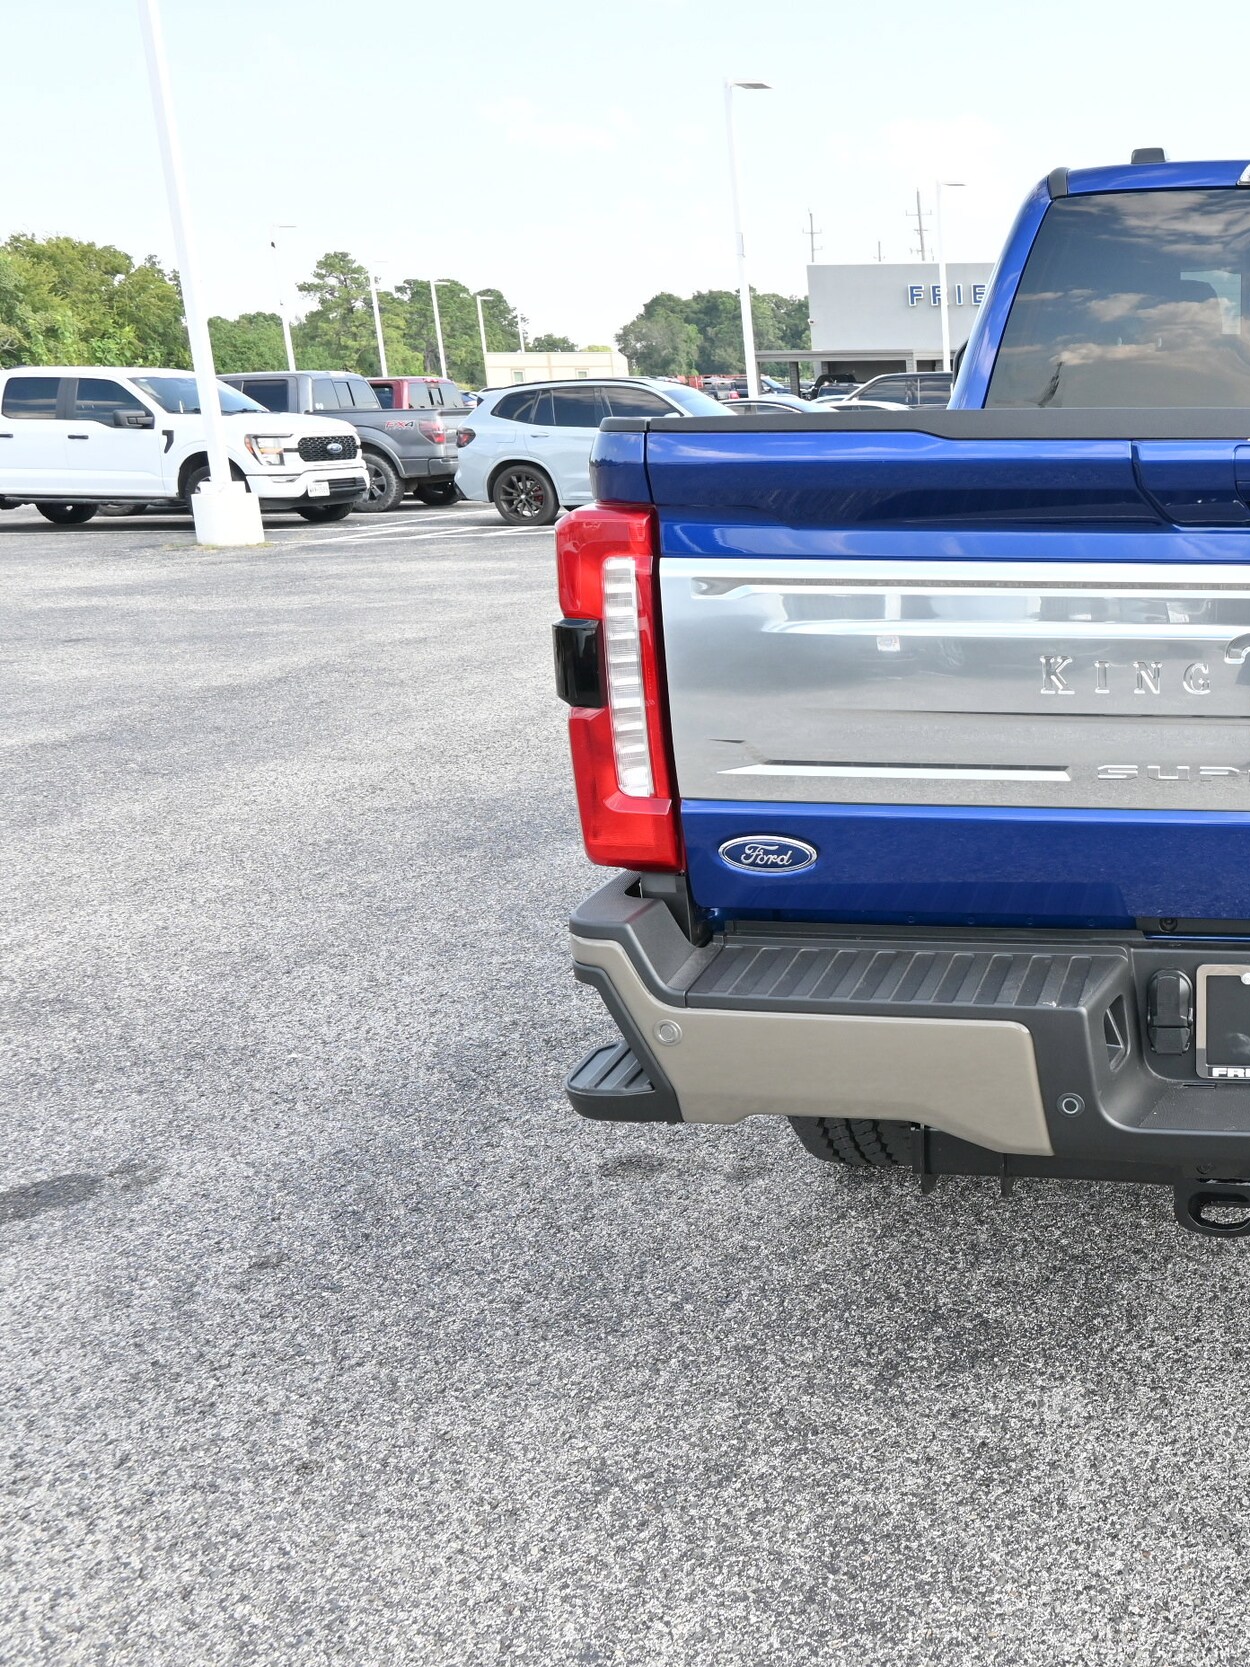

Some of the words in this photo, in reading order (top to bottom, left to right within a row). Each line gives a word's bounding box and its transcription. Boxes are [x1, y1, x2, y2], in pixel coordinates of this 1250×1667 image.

[385, 421, 414, 429] FX4
[1040, 655, 1211, 695] KING
[740, 843, 793, 865] Ford
